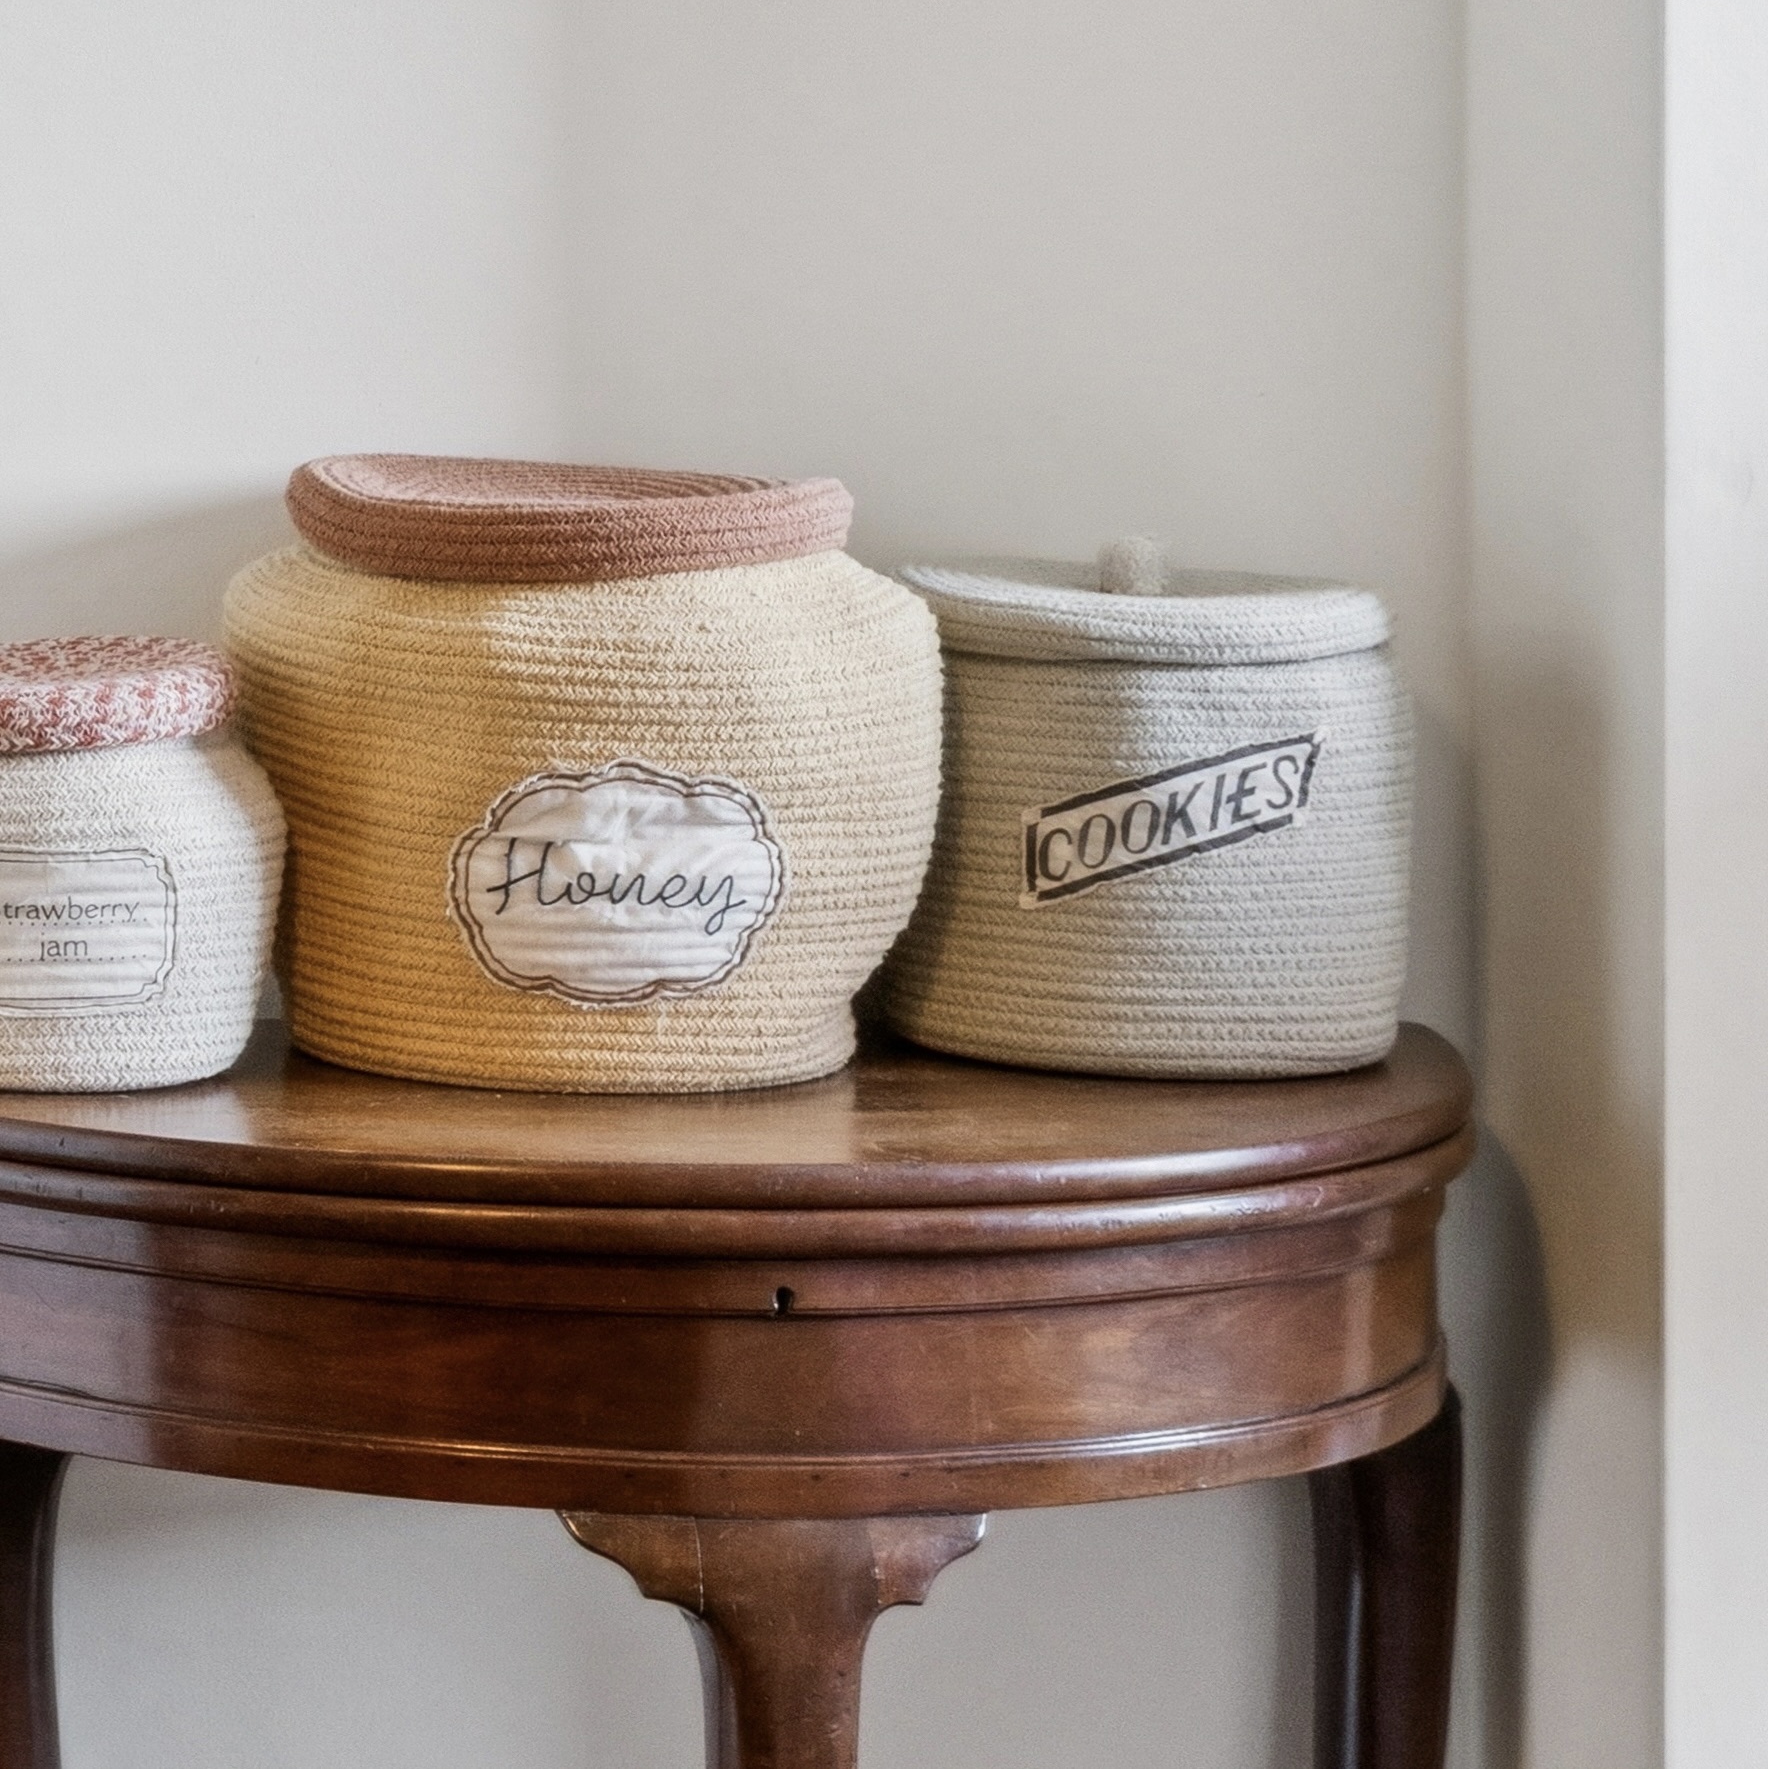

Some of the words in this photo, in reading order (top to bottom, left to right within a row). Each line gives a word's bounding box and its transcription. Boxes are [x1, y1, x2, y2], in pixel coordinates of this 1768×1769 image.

[1038, 754, 1300, 882] COOKIES
[486, 836, 747, 936] Honey
[39, 932, 89, 961] jam
